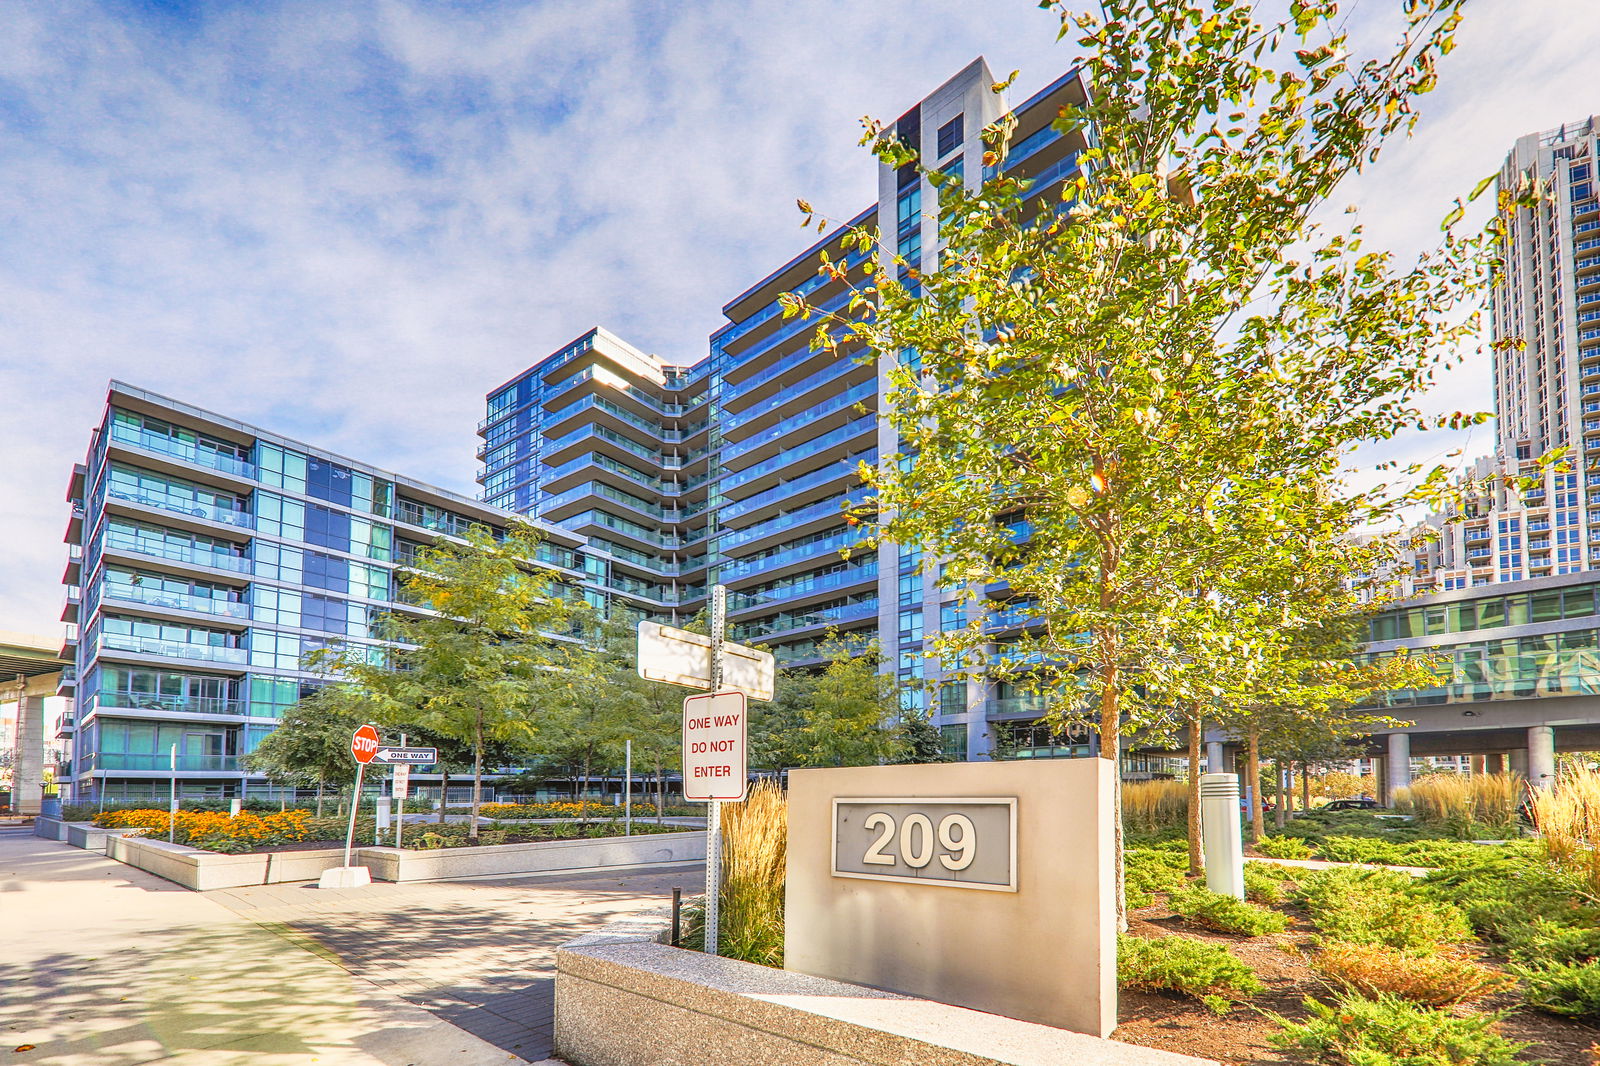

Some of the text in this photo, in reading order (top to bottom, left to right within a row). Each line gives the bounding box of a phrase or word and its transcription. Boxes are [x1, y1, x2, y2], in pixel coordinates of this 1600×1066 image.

[688, 714, 740, 730] ONE WAY
[353, 736, 377, 752] STOP
[691, 740, 735, 754] DO NOT
[694, 765, 731, 778] ENTER
[862, 811, 977, 872] 209
